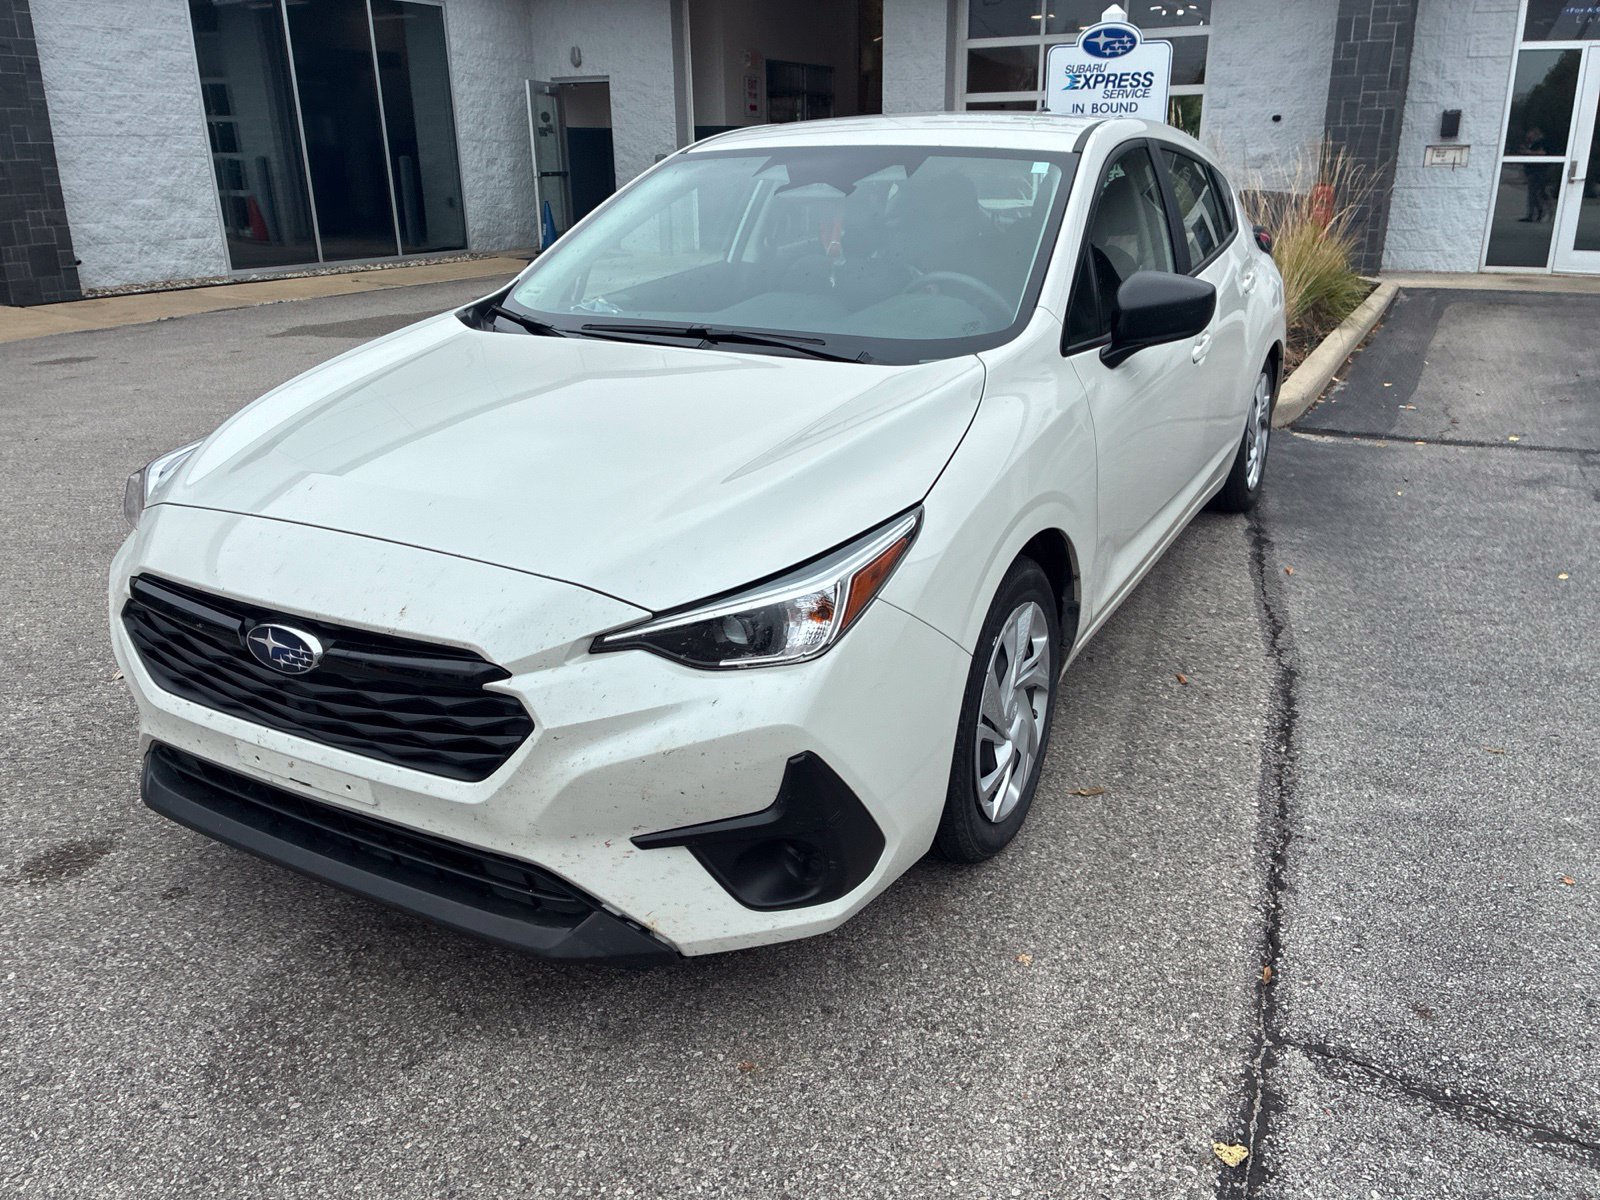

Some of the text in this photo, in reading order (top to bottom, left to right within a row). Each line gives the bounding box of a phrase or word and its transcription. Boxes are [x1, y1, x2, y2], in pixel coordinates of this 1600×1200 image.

[1064, 62, 1109, 74] SUBARU
[1061, 71, 1154, 90] EXPRESS
[1102, 88, 1151, 99] SERVICE
[1071, 102, 1138, 114] IN BOUND
